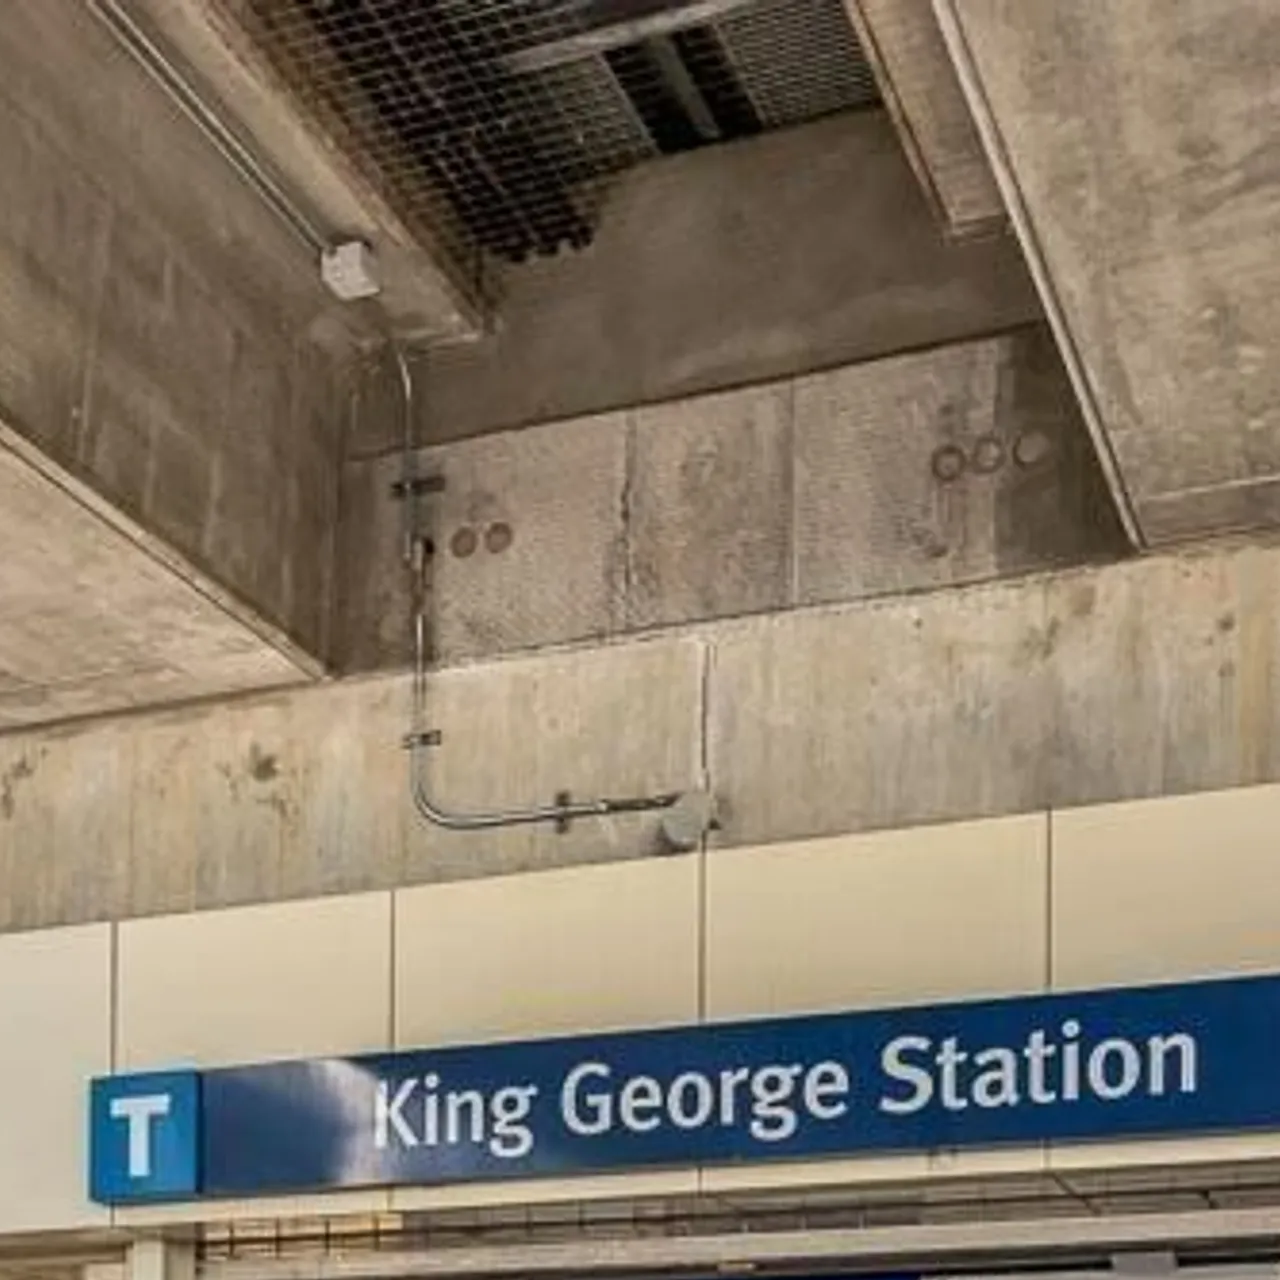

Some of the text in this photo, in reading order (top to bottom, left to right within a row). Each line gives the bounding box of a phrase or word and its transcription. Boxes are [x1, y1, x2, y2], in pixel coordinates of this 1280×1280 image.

[110, 1093, 171, 1178] T
[374, 1018, 1198, 1158] King George Station
